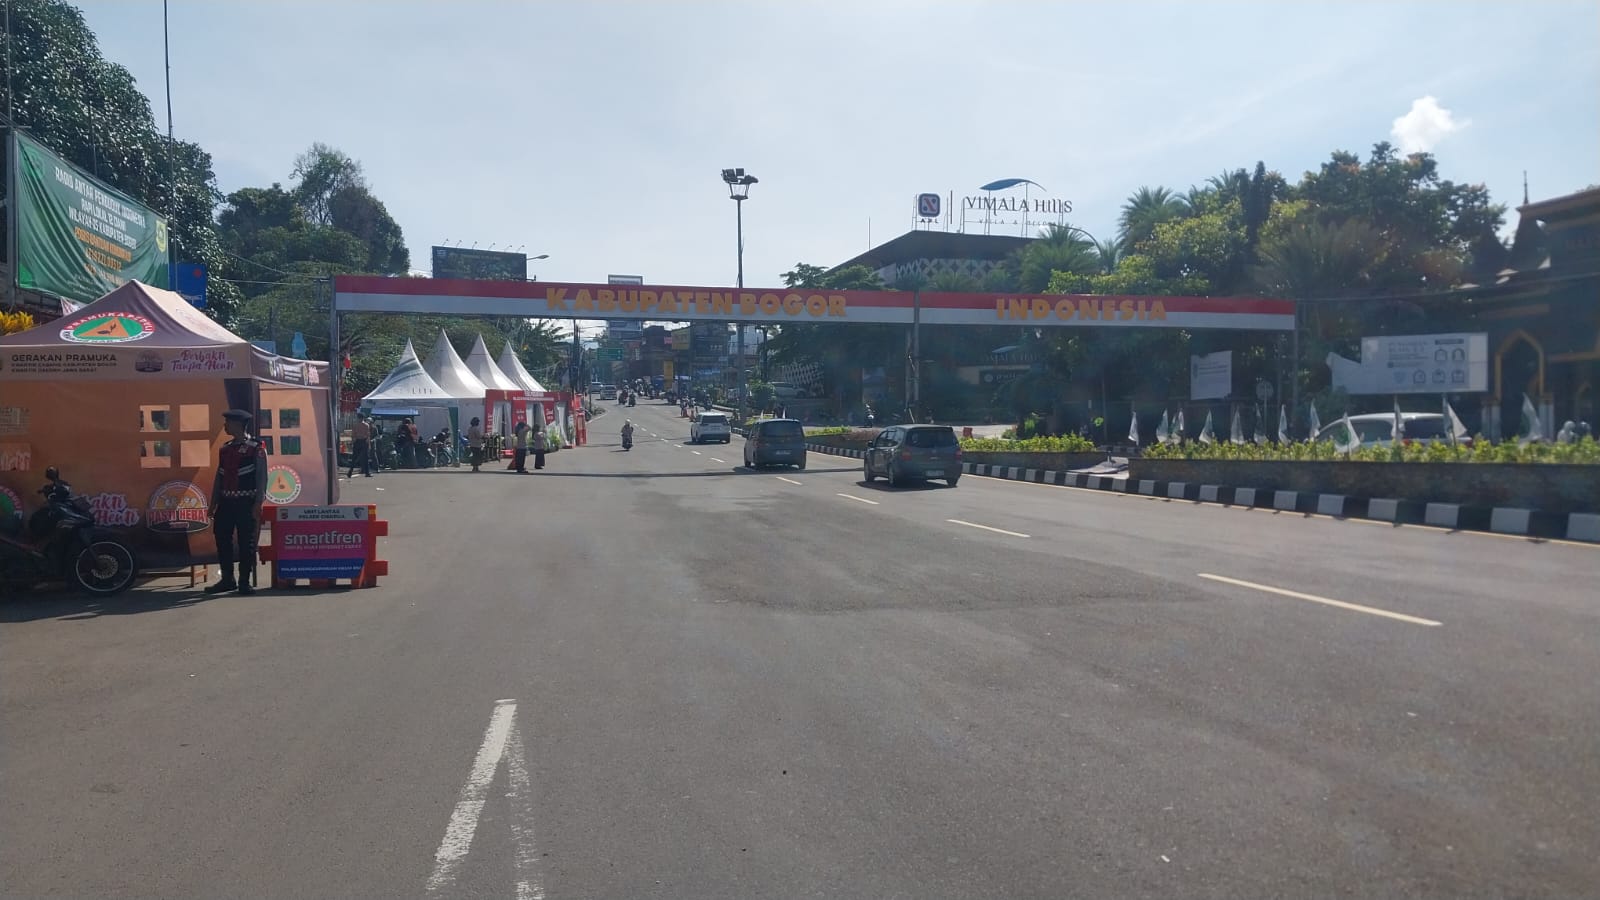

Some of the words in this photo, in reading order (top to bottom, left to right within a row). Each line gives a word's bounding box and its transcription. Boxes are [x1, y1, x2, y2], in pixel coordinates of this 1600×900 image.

[965, 196, 1030, 216] VIMALA
[546, 287, 733, 315] KABUPATEN
[740, 292, 847, 317] BOGOR
[996, 299, 1167, 320] INDONESIA
[285, 531, 361, 544] smartfren
